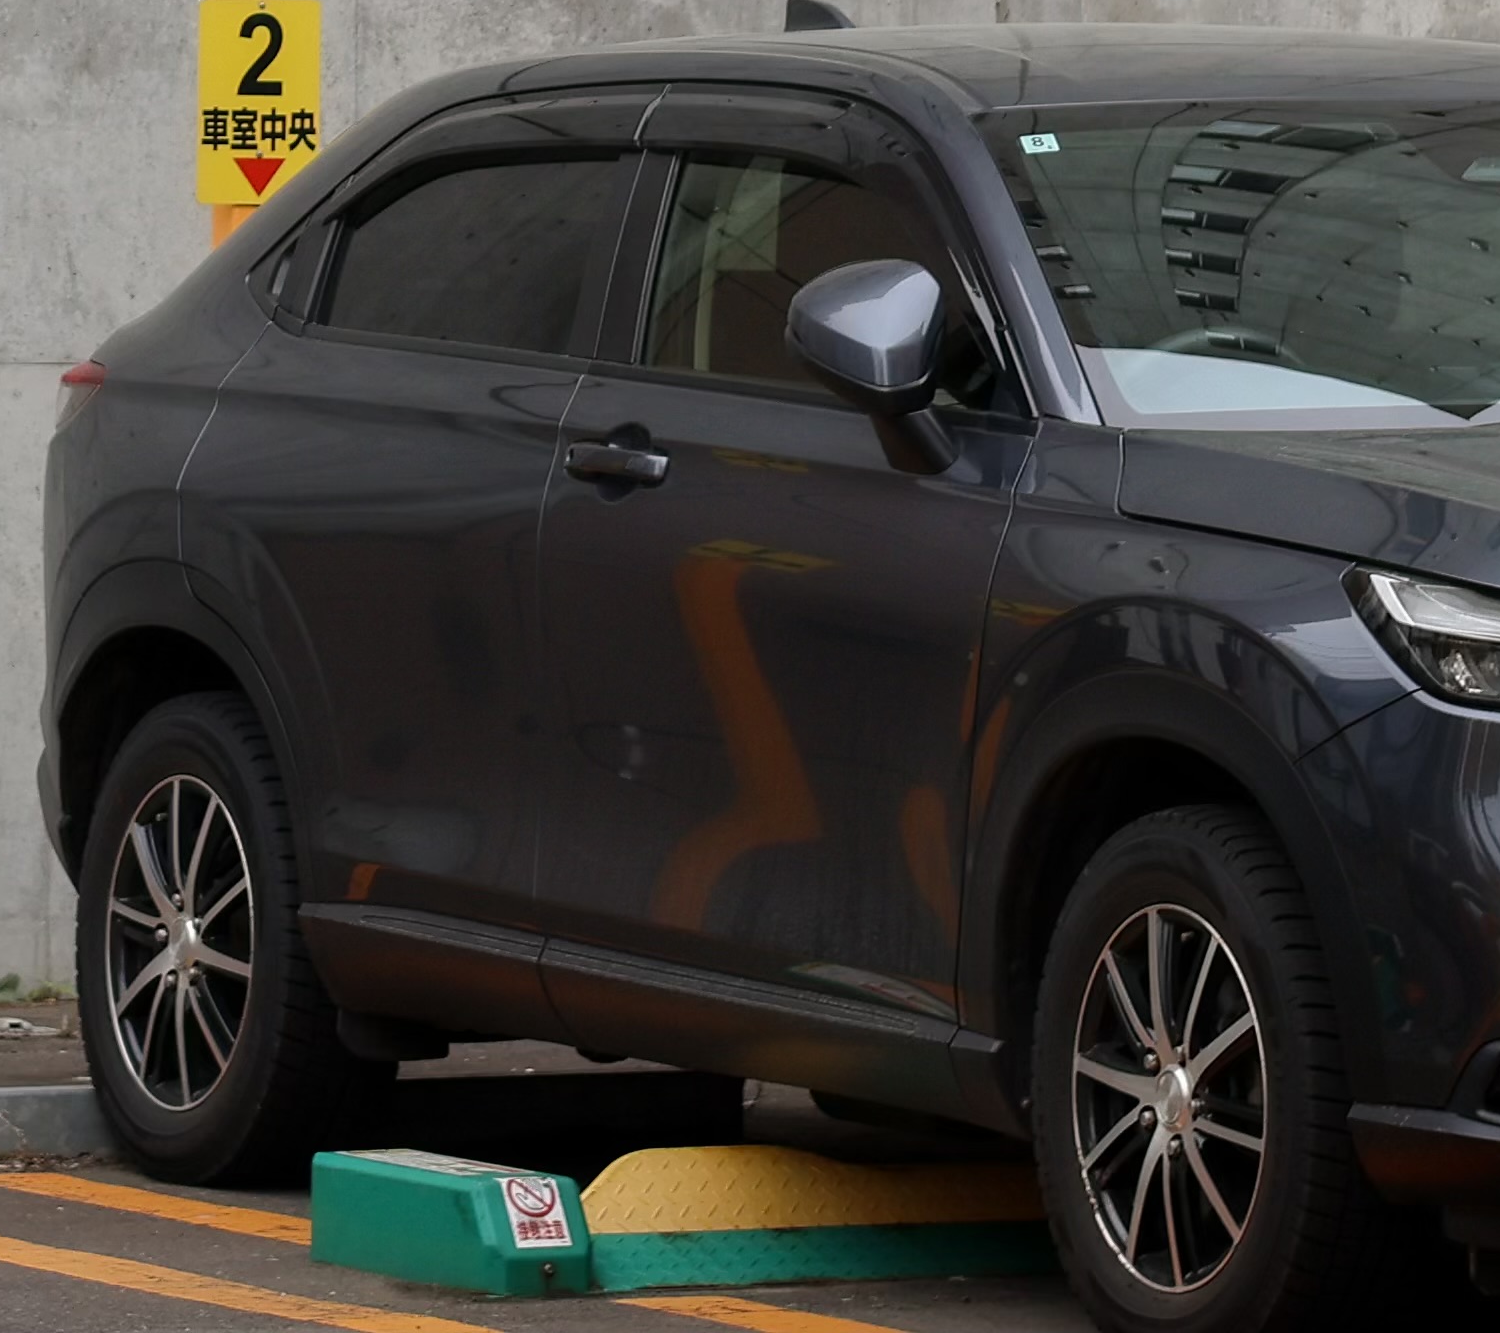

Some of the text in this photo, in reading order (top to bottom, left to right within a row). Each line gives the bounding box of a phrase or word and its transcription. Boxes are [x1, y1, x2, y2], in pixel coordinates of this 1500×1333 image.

[237, 12, 284, 96] 2
[201, 107, 317, 151] 車室中央
